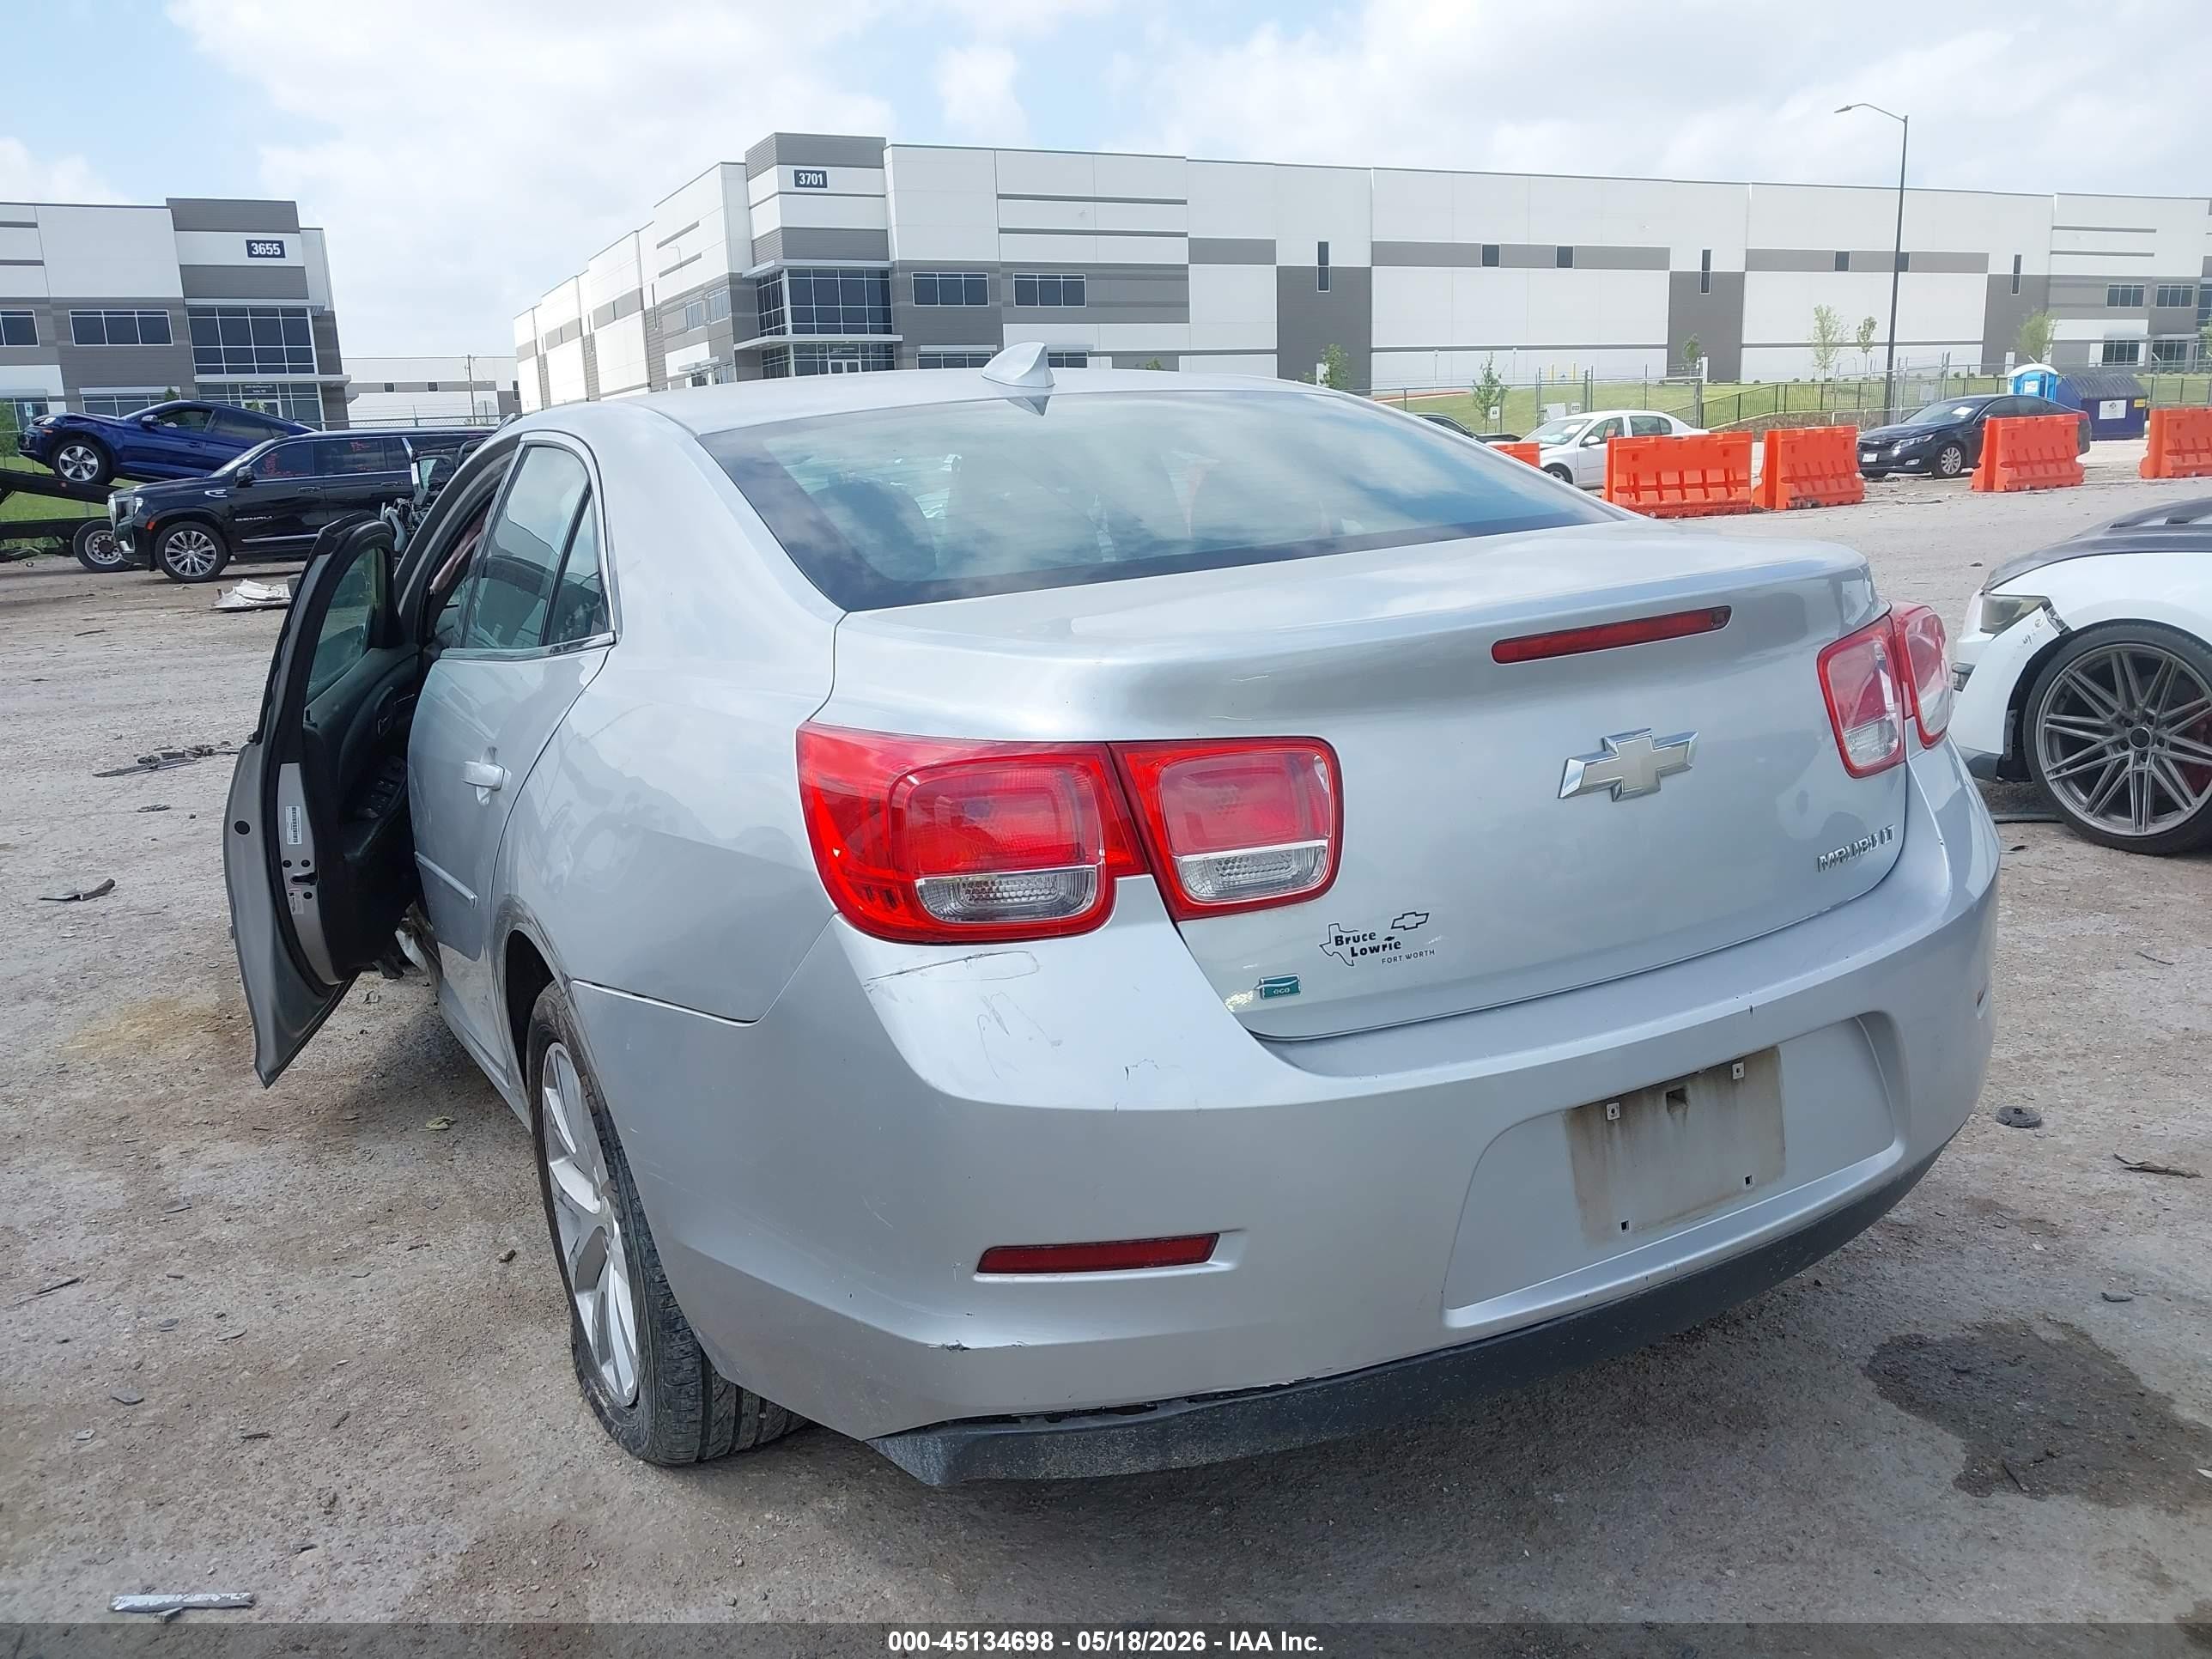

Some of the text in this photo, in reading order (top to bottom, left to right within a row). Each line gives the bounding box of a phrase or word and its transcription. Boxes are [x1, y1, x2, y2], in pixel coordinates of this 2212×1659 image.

[799, 173, 823, 185] 3701
[251, 242, 281, 255] 3655
[1817, 824, 1895, 872] MALIBU LT
[1334, 932, 1376, 946] Bruce
[1350, 939, 1401, 957] Lowrie
[1382, 949, 1435, 964] FORT WORTH
